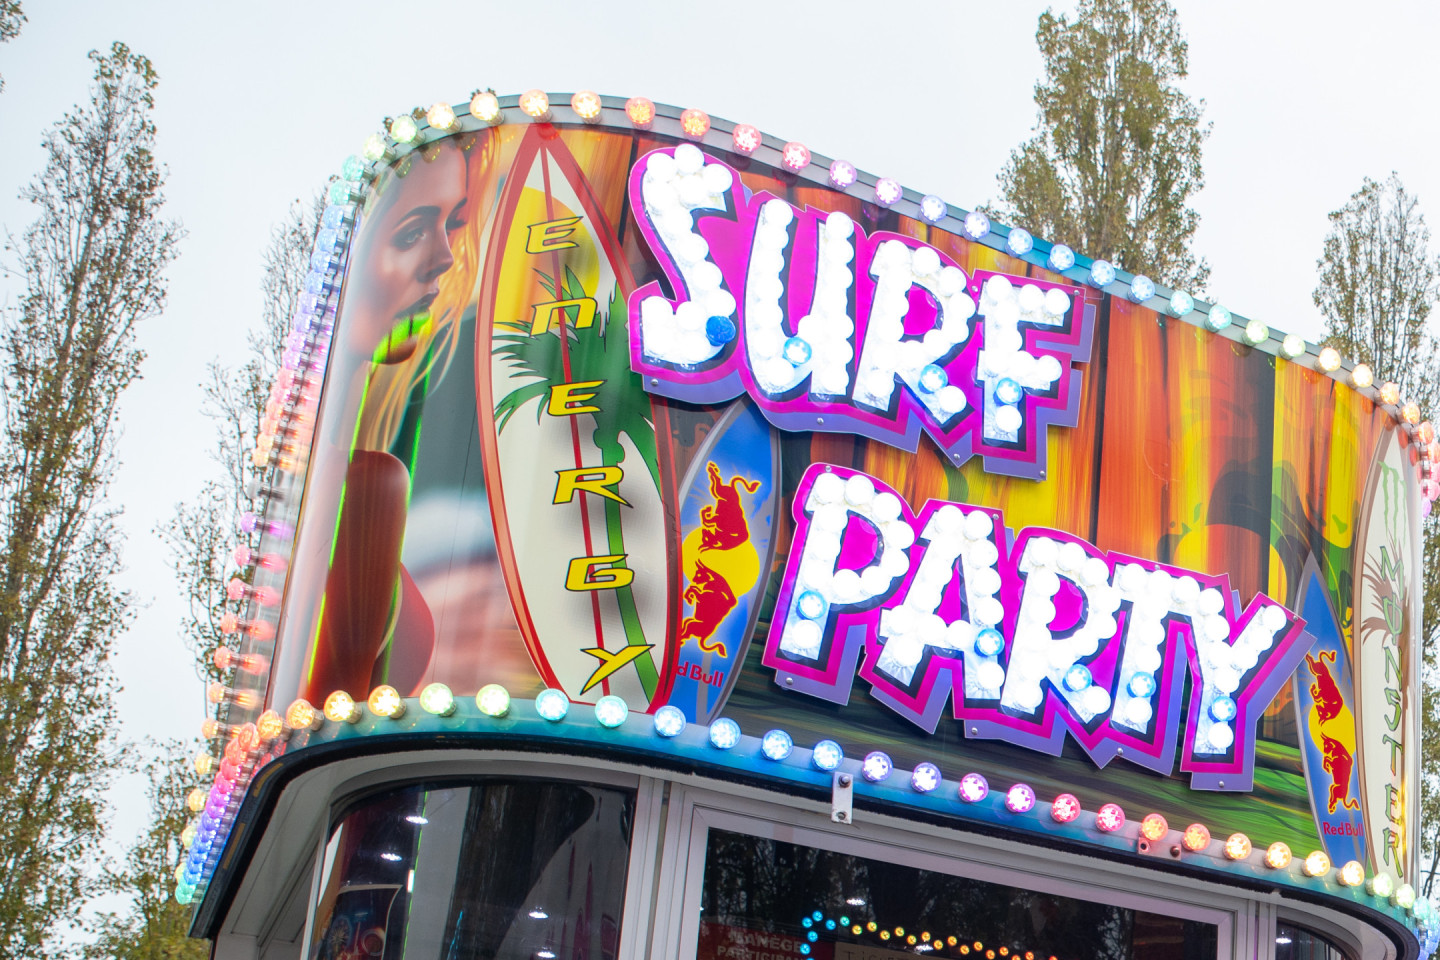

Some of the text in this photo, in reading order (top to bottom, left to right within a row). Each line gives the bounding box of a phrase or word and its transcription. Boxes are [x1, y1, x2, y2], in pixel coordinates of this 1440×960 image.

[634, 144, 1078, 450] SURF
[525, 215, 656, 695] ENERGY
[689, 664, 724, 688] Bull
[778, 469, 1290, 760] PARTY
[1322, 821, 1364, 837] Red Bull
